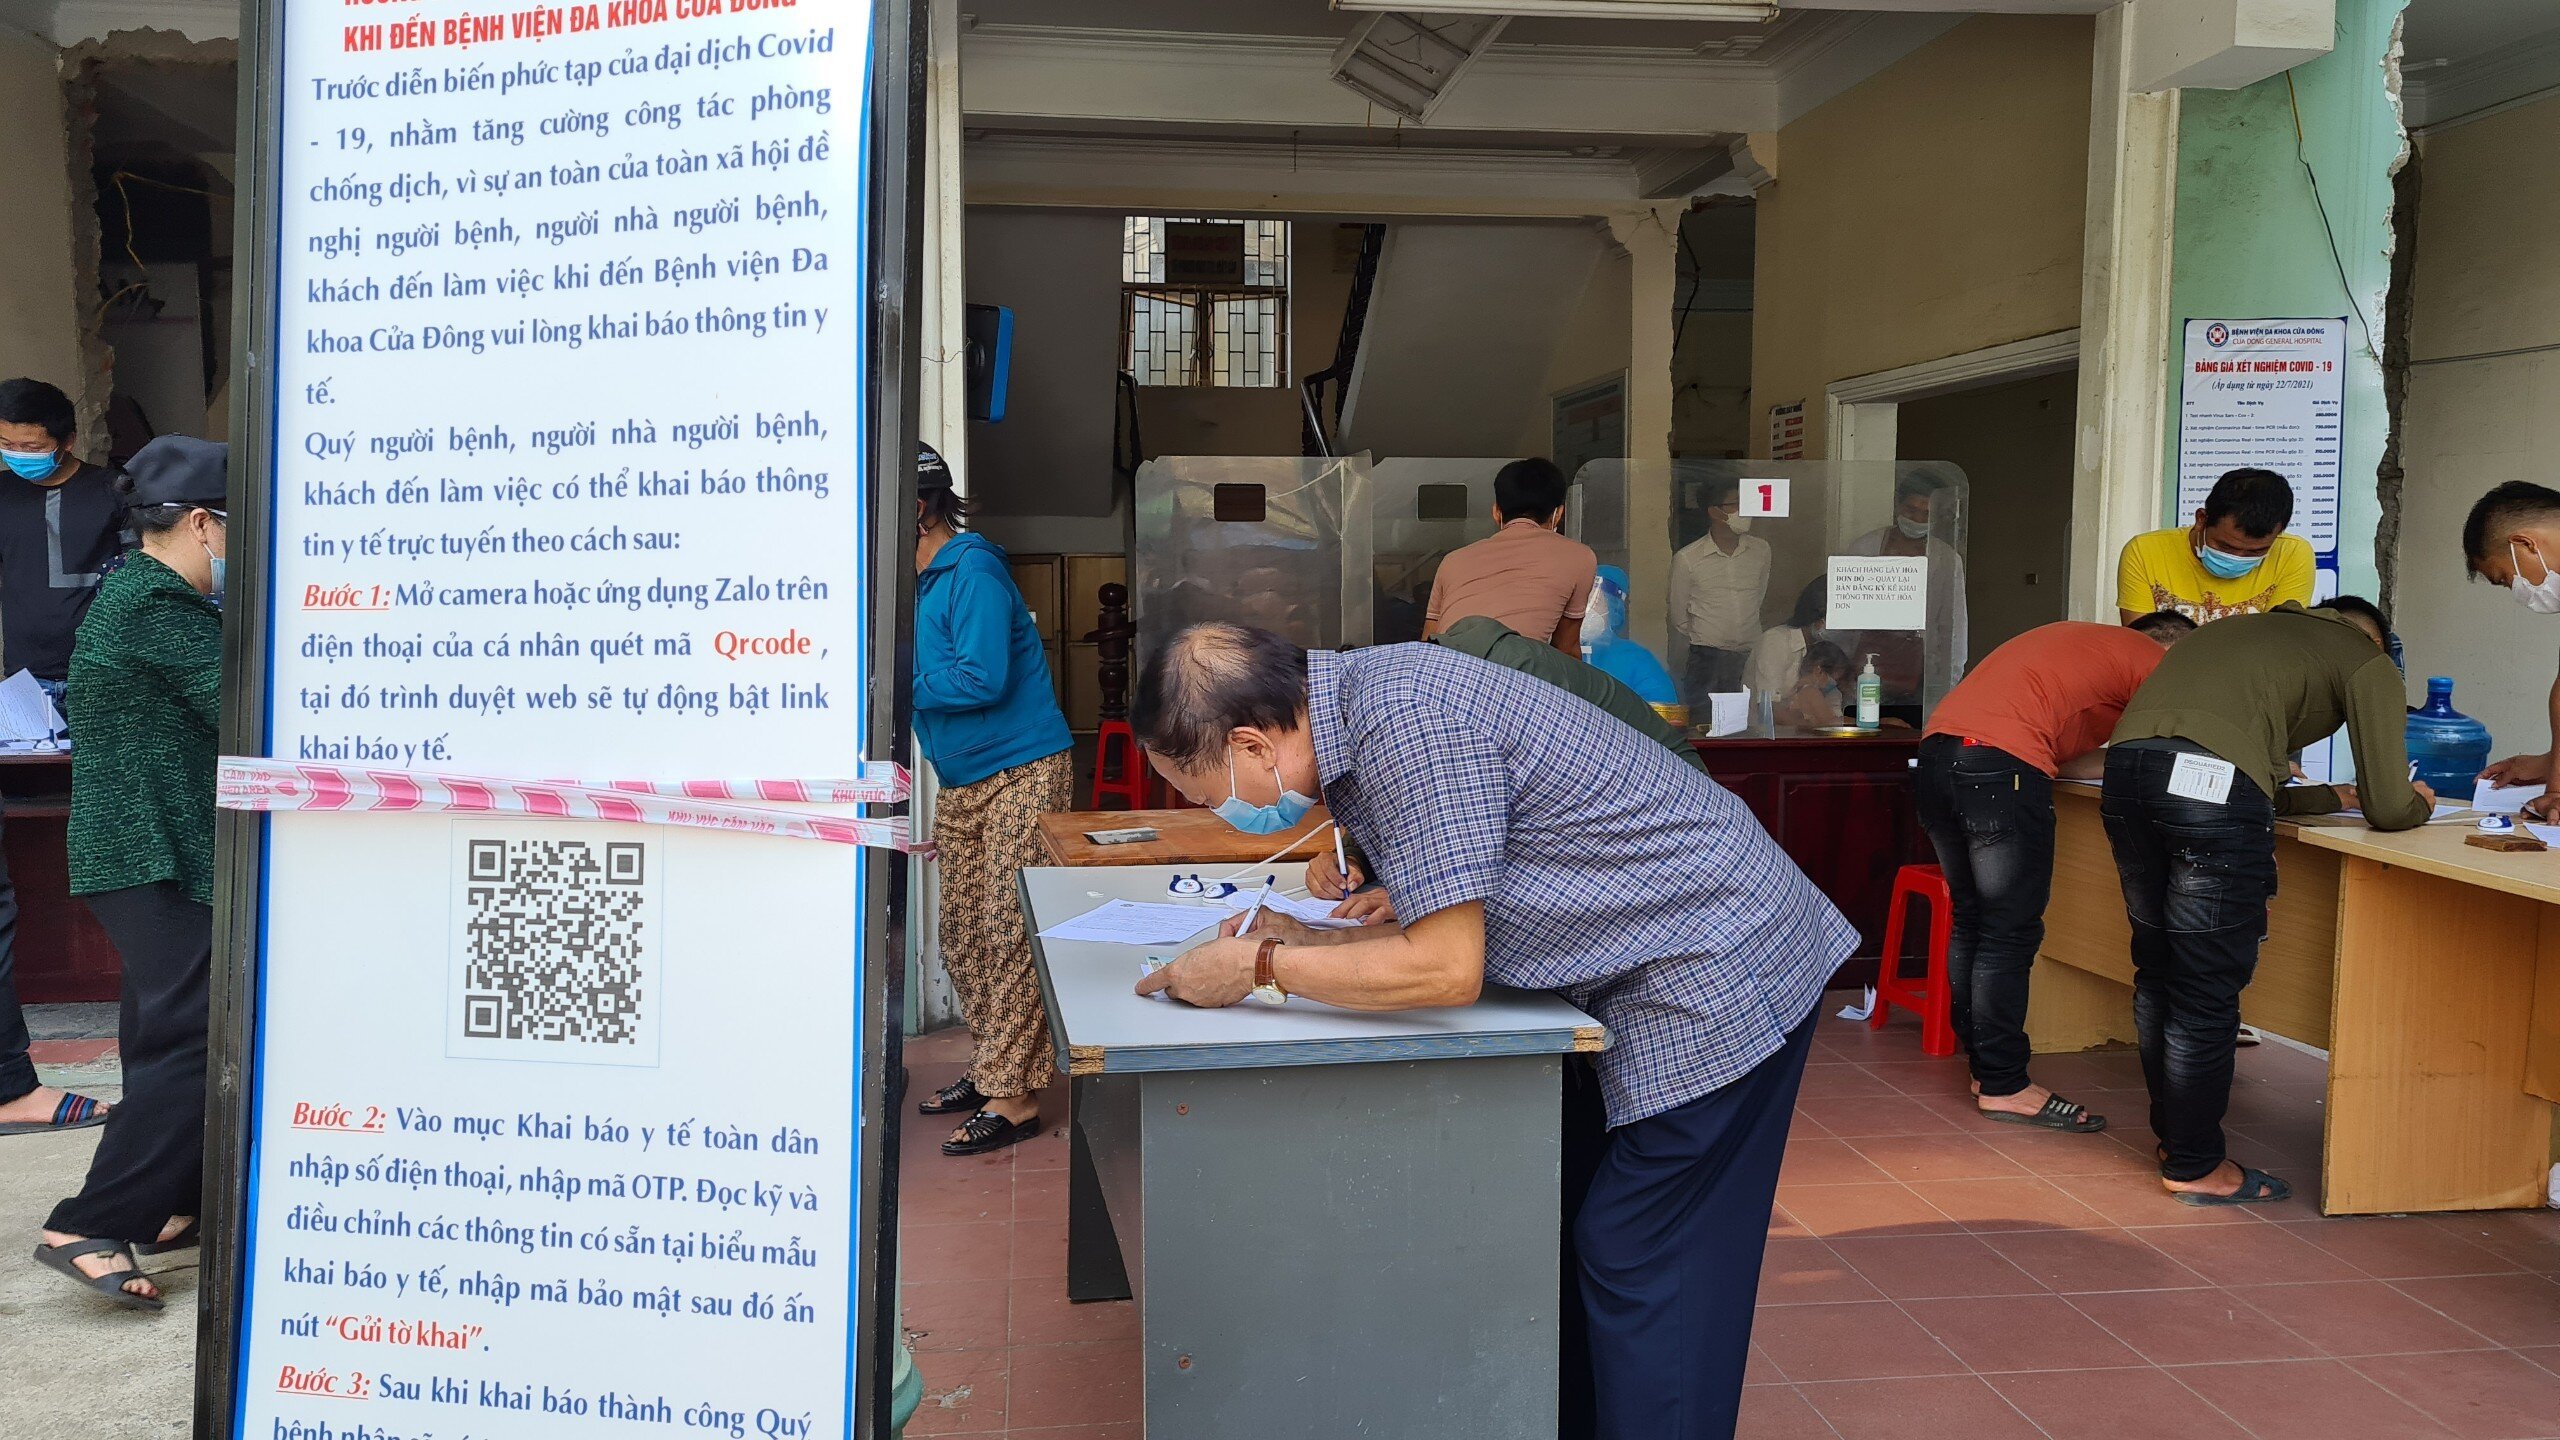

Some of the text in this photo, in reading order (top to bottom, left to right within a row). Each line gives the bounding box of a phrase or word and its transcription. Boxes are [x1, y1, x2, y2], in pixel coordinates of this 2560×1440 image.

[344, 24, 382, 53] KHI
[389, 16, 436, 50] ĐẾN
[443, 11, 504, 46] BỆNH
[511, 4, 563, 39] VIỆN
[569, 3, 600, 33] ĐA
[607, 0, 668, 29] KHOA
[311, 27, 834, 101] Trước diễn biến phức tạp của đại dịch Covid
[336, 127, 373, 154] 19,
[390, 118, 457, 148] nhằm
[472, 118, 525, 146] tăng
[539, 108, 609, 138] cường
[624, 100, 682, 130] công
[696, 91, 735, 119] tác
[751, 84, 832, 121] phòng
[308, 247, 828, 303] khách đến làm việc khi đến Bệnh viện Đa
[2195, 358, 2218, 373] BẢNG
[2220, 359, 2234, 373] GIÁ
[2236, 359, 2251, 373] XÉT
[2253, 359, 2287, 374] NGHIỆM
[2289, 361, 2314, 372] COVID
[2322, 361, 2332, 372] 19
[305, 376, 336, 405] tế.
[1757, 484, 1772, 511] 1
[303, 575, 828, 612] Bước 1: Mở camera hoặc ứng dụng Zalo trên
[301, 628, 811, 665] điện thoại của cá nhân quét mã Qrcode
[290, 1102, 819, 1155] Bước 2: Vào mục Khai báo y tế toàn dân
[280, 1311, 320, 1338] nút
[388, 1319, 413, 1345] tờ
[278, 1365, 812, 1440] Bước 3: Sau khi khai báo thành công Quý
